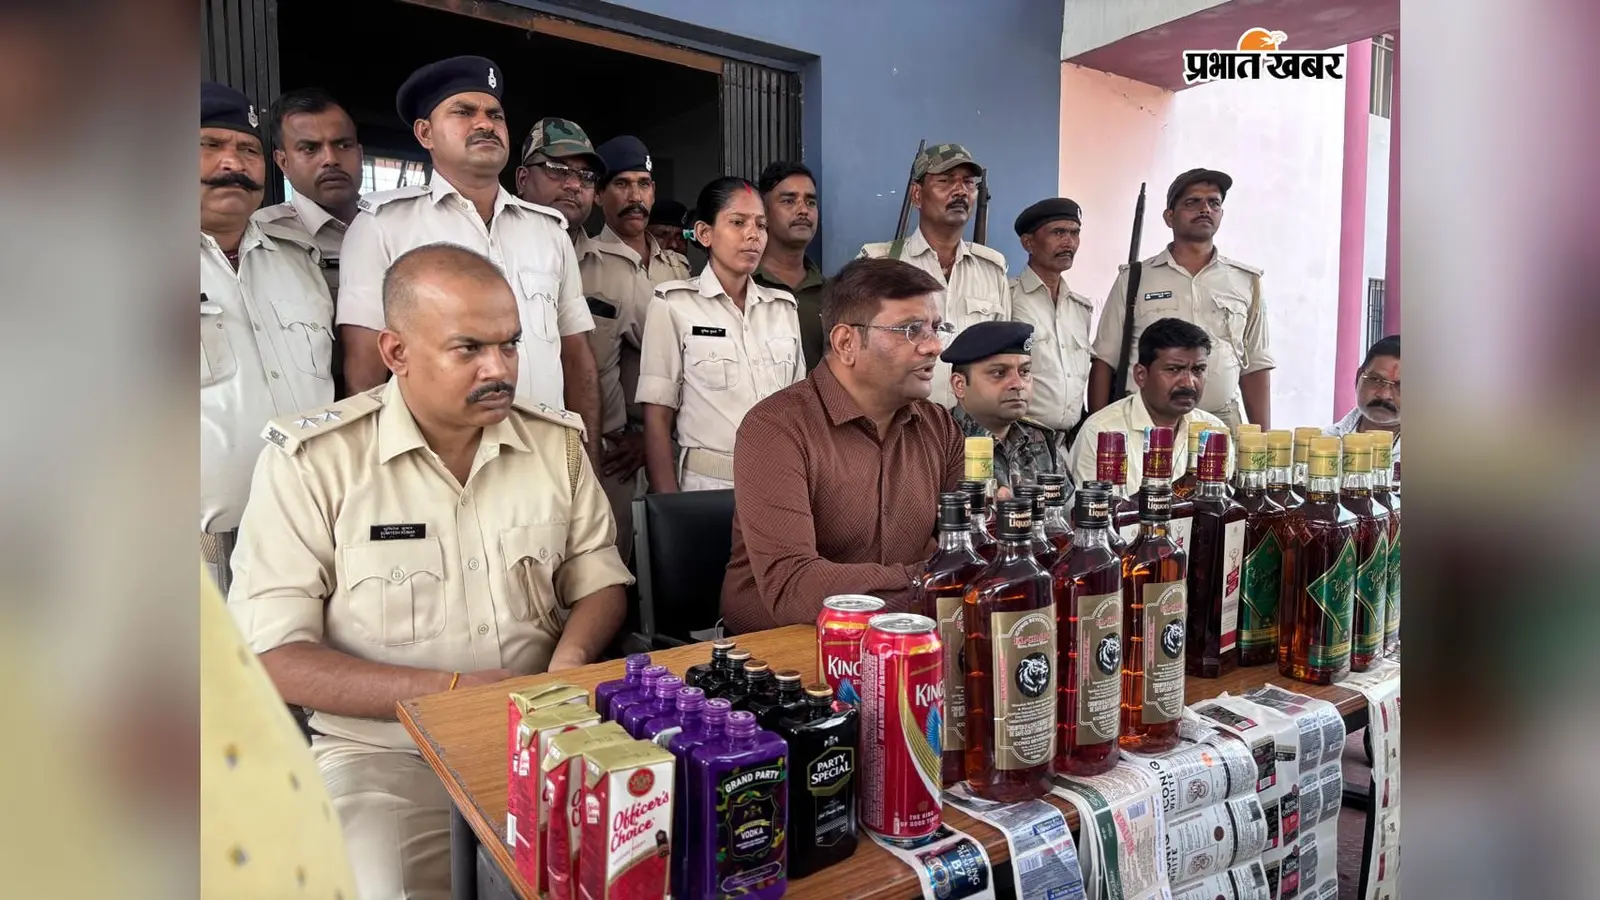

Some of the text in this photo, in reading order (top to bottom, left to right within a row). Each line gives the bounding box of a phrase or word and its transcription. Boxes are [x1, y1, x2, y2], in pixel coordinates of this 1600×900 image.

[811, 761, 851, 785] SPECIAL
[817, 753, 846, 772] PARTY
[724, 770, 780, 794] GRAND PARTY
[613, 790, 669, 832] Officer's
[610, 819, 654, 853] Choice
[740, 826, 764, 840] VODKA
[951, 859, 966, 876] B7
[957, 844, 981, 886] STERLING
